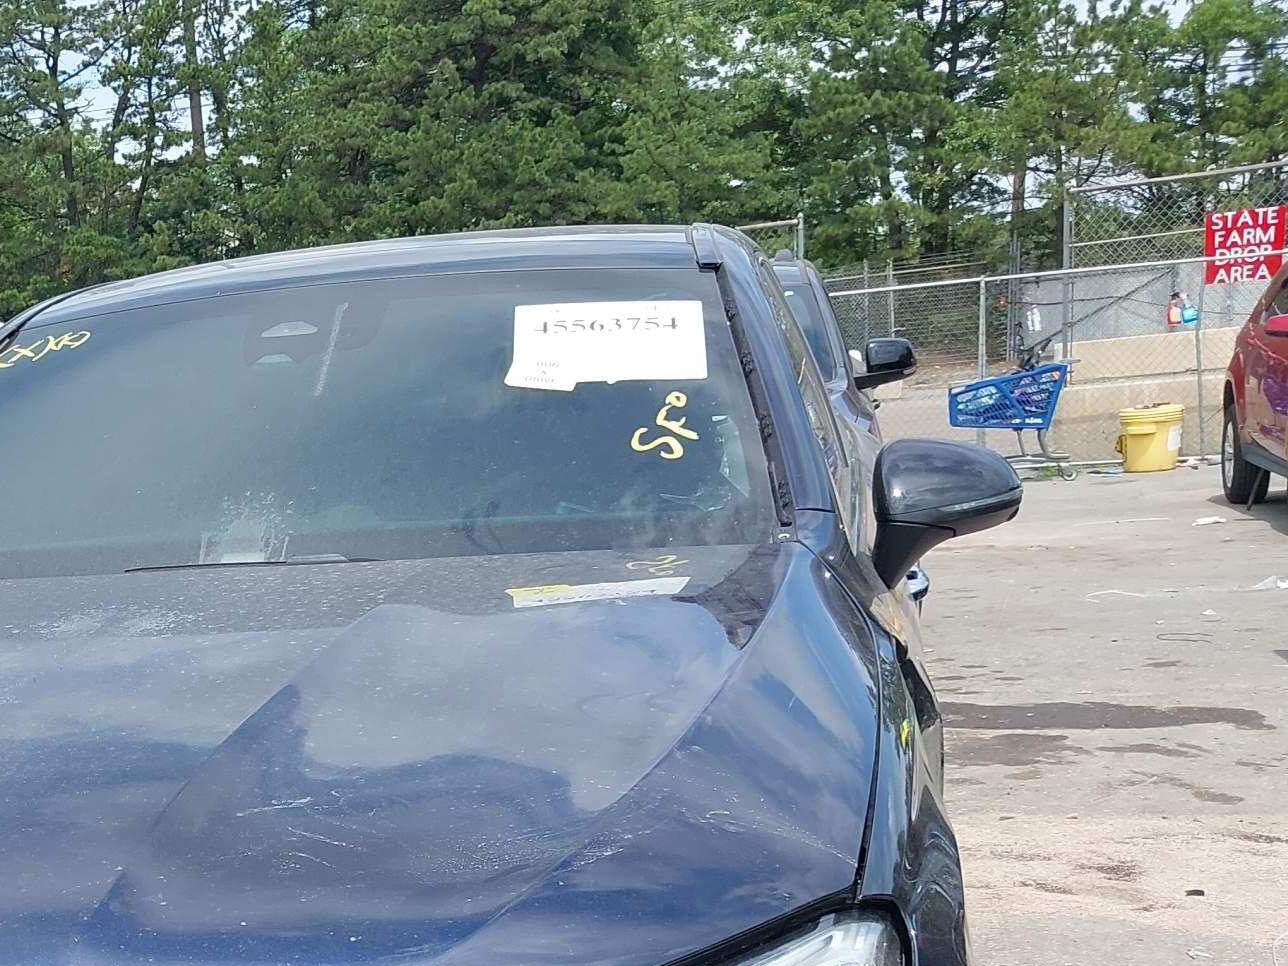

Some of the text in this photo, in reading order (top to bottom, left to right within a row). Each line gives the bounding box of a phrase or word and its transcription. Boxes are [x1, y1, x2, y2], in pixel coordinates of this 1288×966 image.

[1211, 206, 1279, 229] STATE
[1214, 225, 1275, 248] FARM
[1215, 244, 1272, 265] DROP
[1213, 263, 1271, 284] AREA
